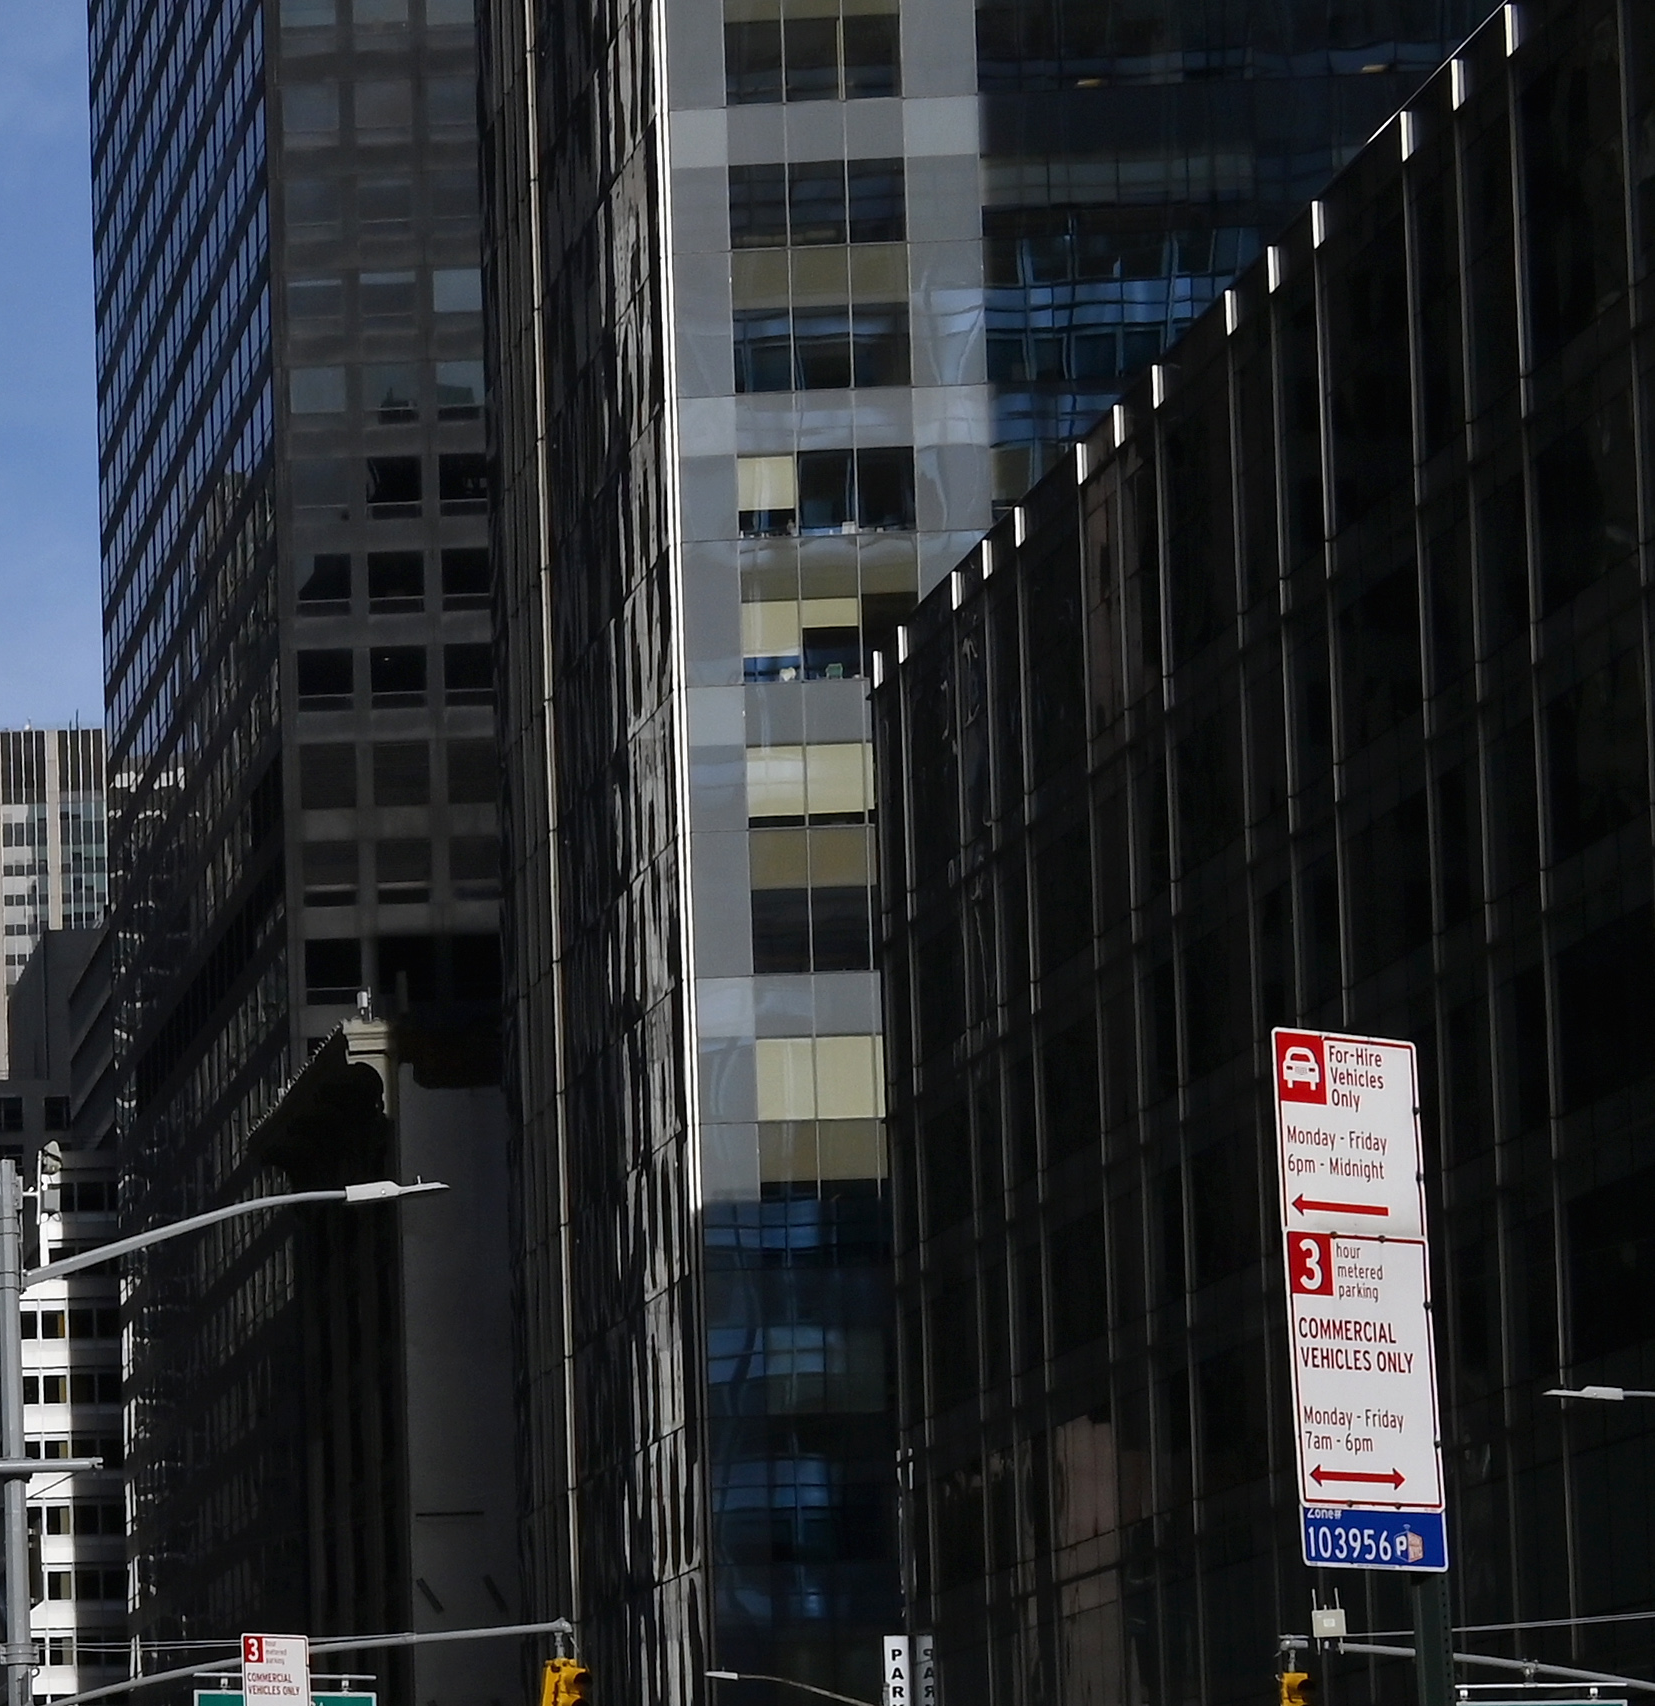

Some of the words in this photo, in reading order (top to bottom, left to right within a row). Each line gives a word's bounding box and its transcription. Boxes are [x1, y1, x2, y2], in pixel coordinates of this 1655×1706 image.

[1329, 1045, 1382, 1067] For-Hire
[1330, 1067, 1383, 1089] Vehicles
[1332, 1089, 1360, 1112] Only
[1287, 1125, 1335, 1151] Monday
[1349, 1131, 1387, 1155] Friday
[1288, 1154, 1315, 1176] 6pm
[1330, 1157, 1384, 1182] Midnight
[1336, 1243, 1361, 1259] hour
[1299, 1239, 1322, 1290] 3
[1338, 1264, 1383, 1280] metered
[1338, 1283, 1378, 1302] parking
[1299, 1317, 1396, 1344] COMMERCIAL
[1301, 1346, 1371, 1371] VEHICLES
[1377, 1351, 1413, 1374] ONLY
[1304, 1405, 1353, 1431] Monday
[1365, 1409, 1404, 1434] Friday
[1305, 1431, 1332, 1450] 7am
[1345, 1432, 1373, 1455] 6pm
[1308, 1526, 1392, 1560] 103956
[248, 1638, 259, 1661] 3
[247, 1672, 292, 1683] COMMERCIAL
[248, 1685, 281, 1695] VEHICLES
[283, 1686, 300, 1696] ONLY
